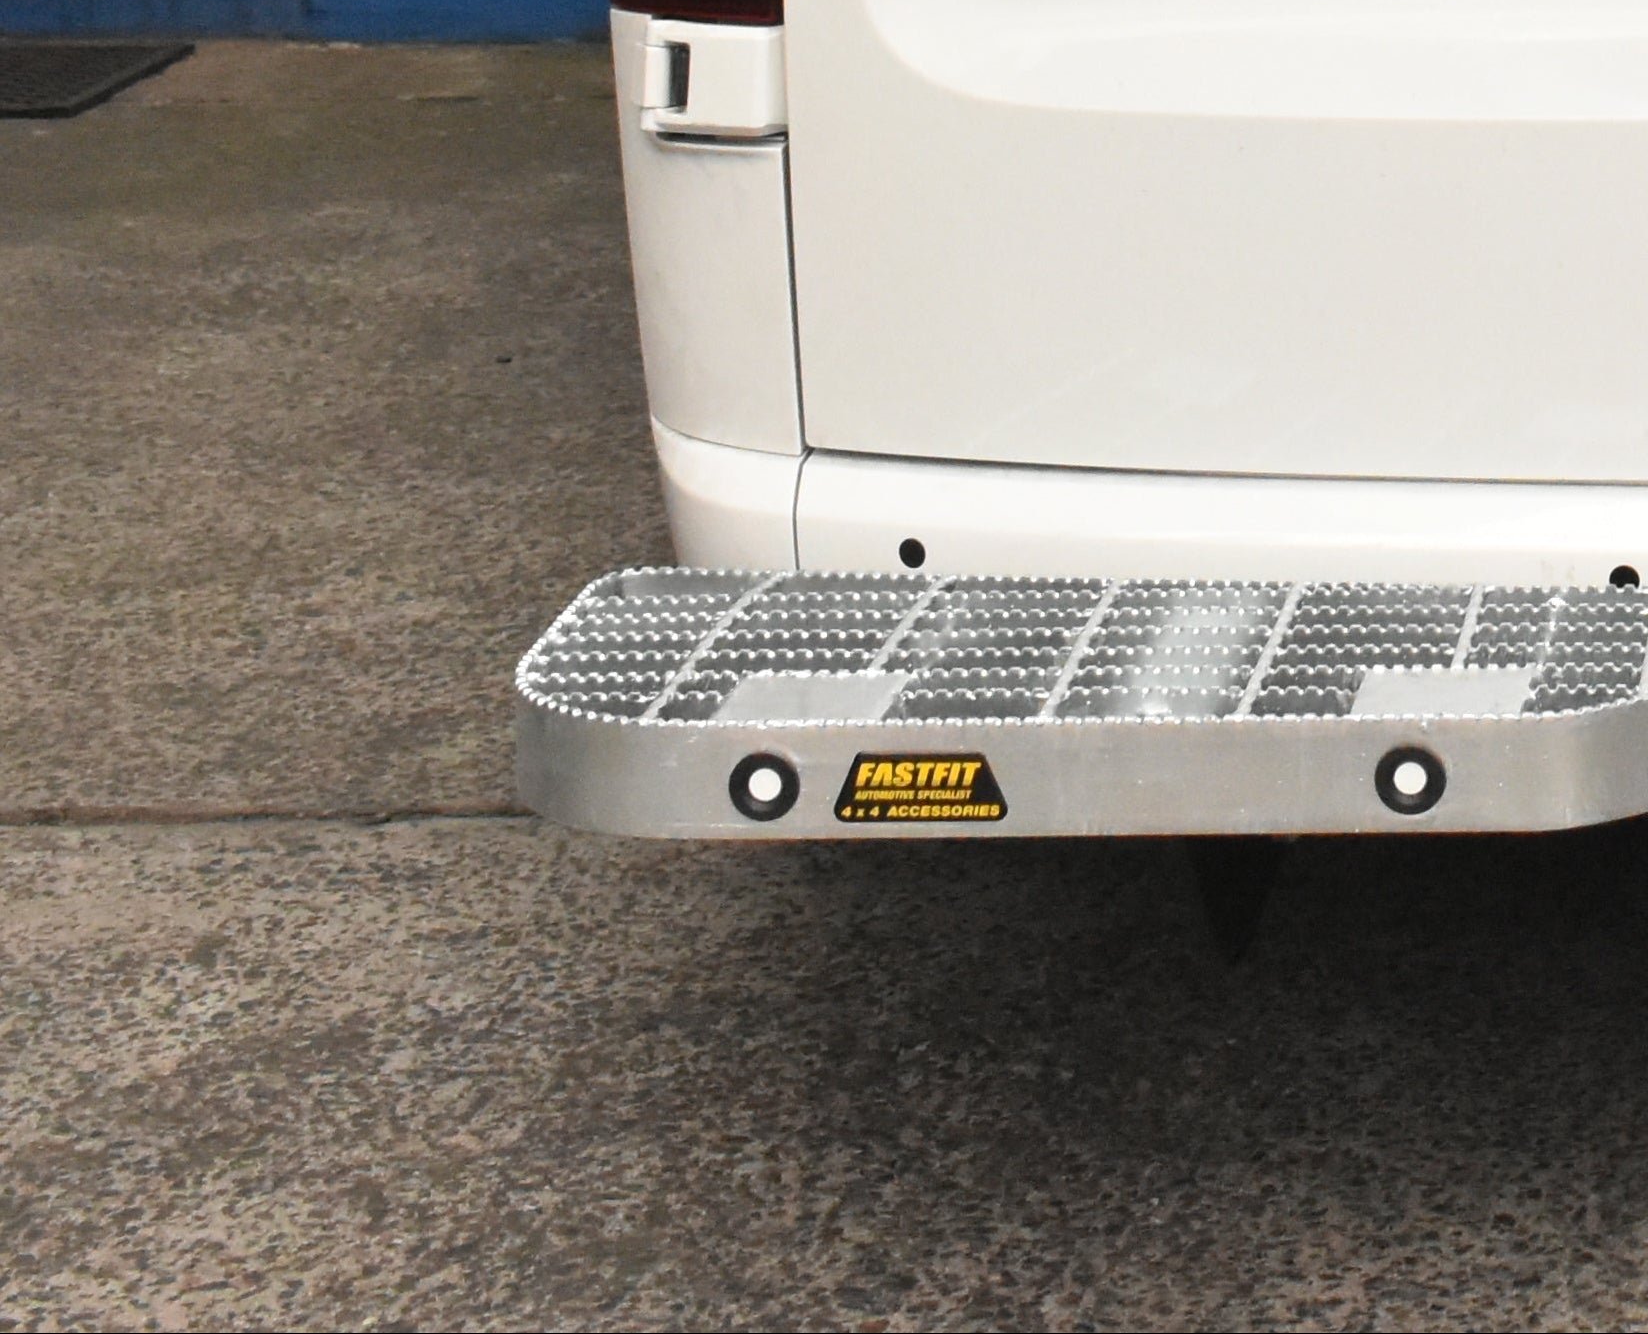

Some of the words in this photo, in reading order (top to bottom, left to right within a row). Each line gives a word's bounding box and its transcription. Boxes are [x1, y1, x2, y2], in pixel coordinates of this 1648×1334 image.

[855, 762, 981, 787] FASTFIT
[855, 790, 915, 800] AUTOMOTIVE
[917, 790, 972, 799] SPECIALIST
[886, 804, 1000, 817] ACCESSORIES
